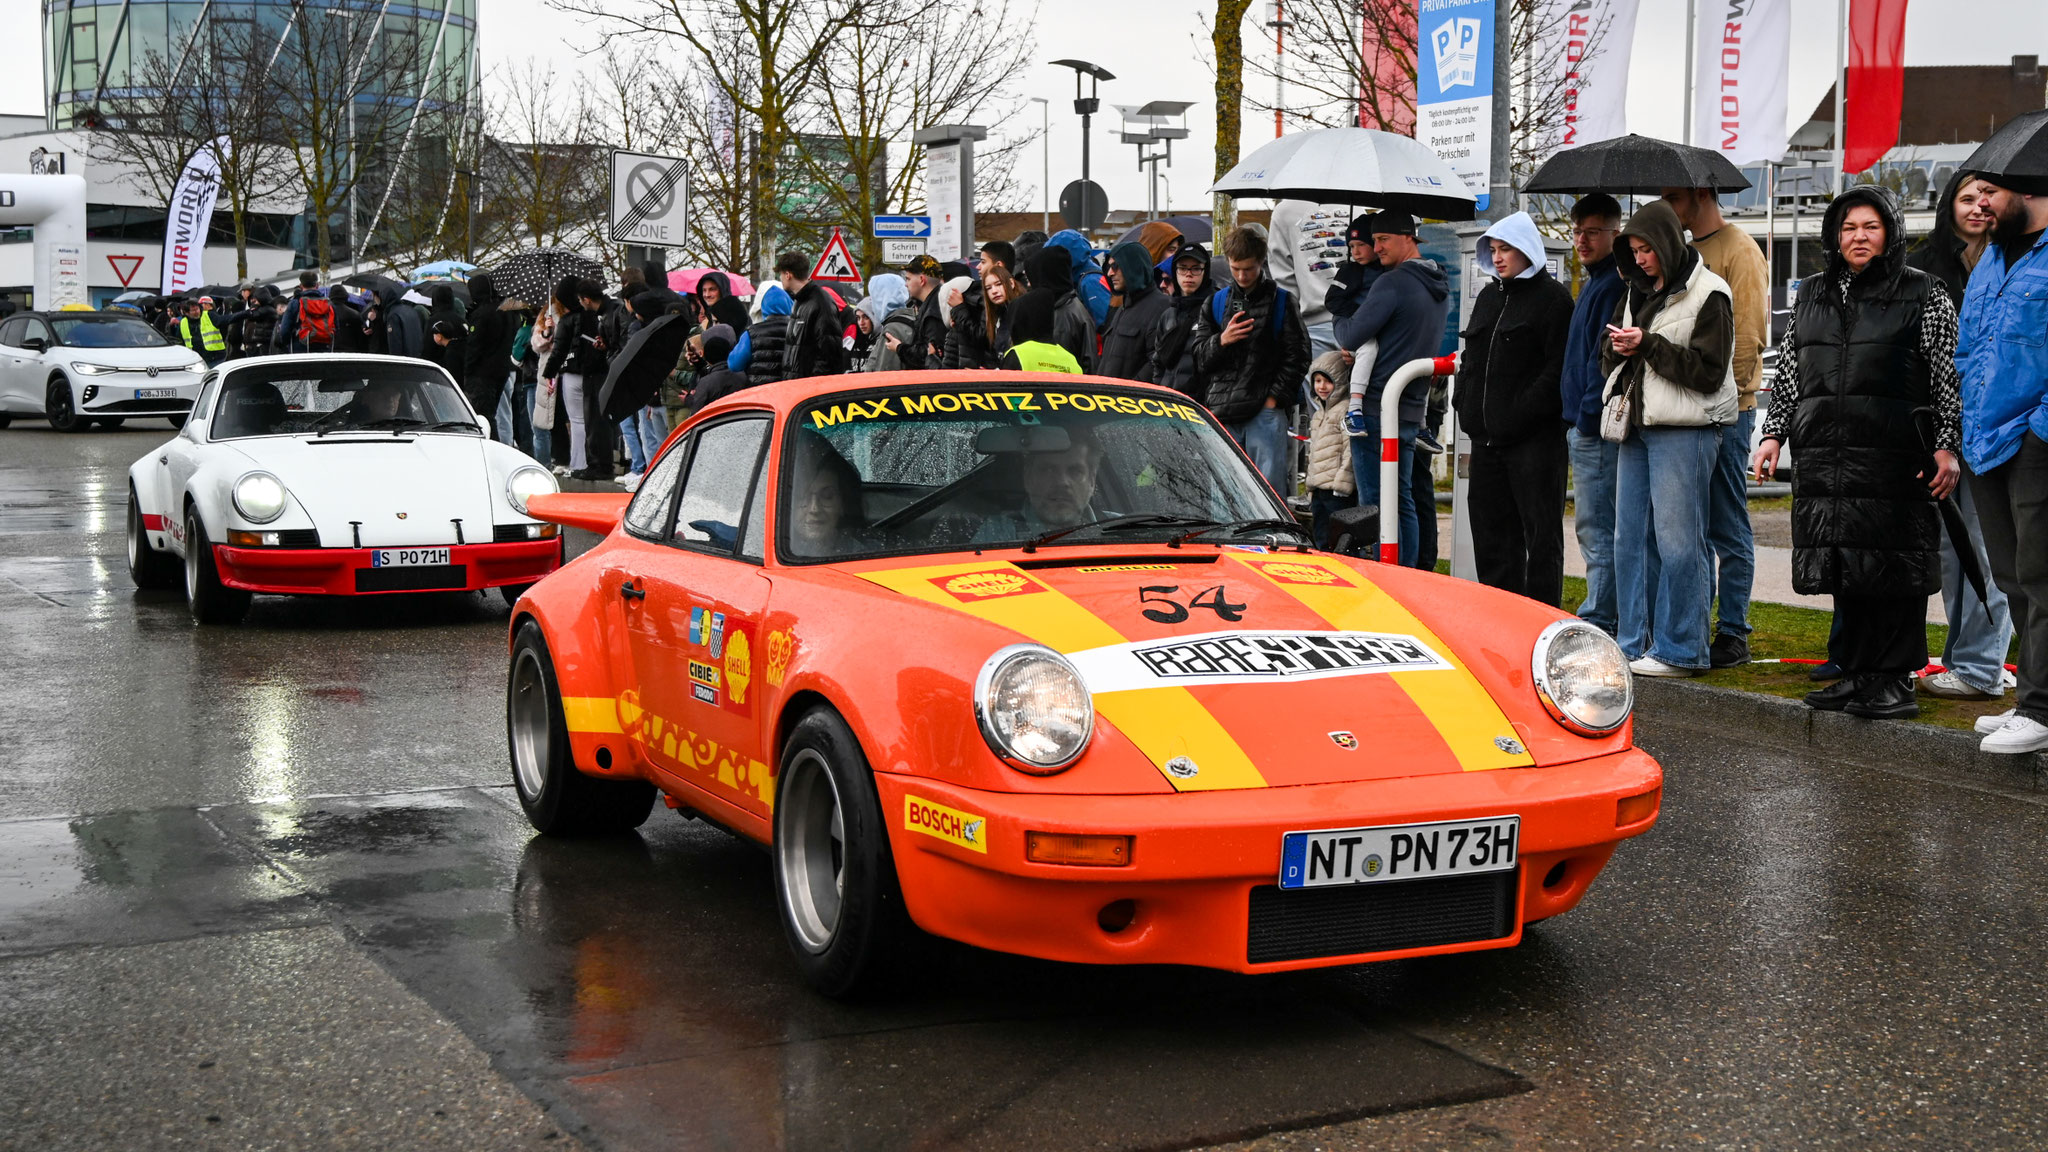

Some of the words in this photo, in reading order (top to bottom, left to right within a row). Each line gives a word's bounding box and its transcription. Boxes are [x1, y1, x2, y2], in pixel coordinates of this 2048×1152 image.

[1431, 135, 1452, 147] Parken
[1453, 136, 1463, 144] nur
[1465, 132, 1475, 143] mit
[1437, 147, 1470, 160] Parkschein
[631, 223, 669, 240] ZONE
[891, 243, 918, 251] Schritt
[810, 398, 899, 429] MAX
[900, 392, 1043, 415] MORITZ
[1044, 393, 1207, 426] PORSCHE
[381, 551, 391, 566] S
[957, 578, 1020, 590] SHELL
[1138, 584, 1248, 625] 54
[727, 655, 748, 678] SHELL
[909, 801, 962, 839] BOSCH
[1309, 836, 1363, 881] NT
[1389, 830, 1440, 875] PN
[1447, 823, 1517, 869] 73H
[1288, 865, 1298, 878] D
